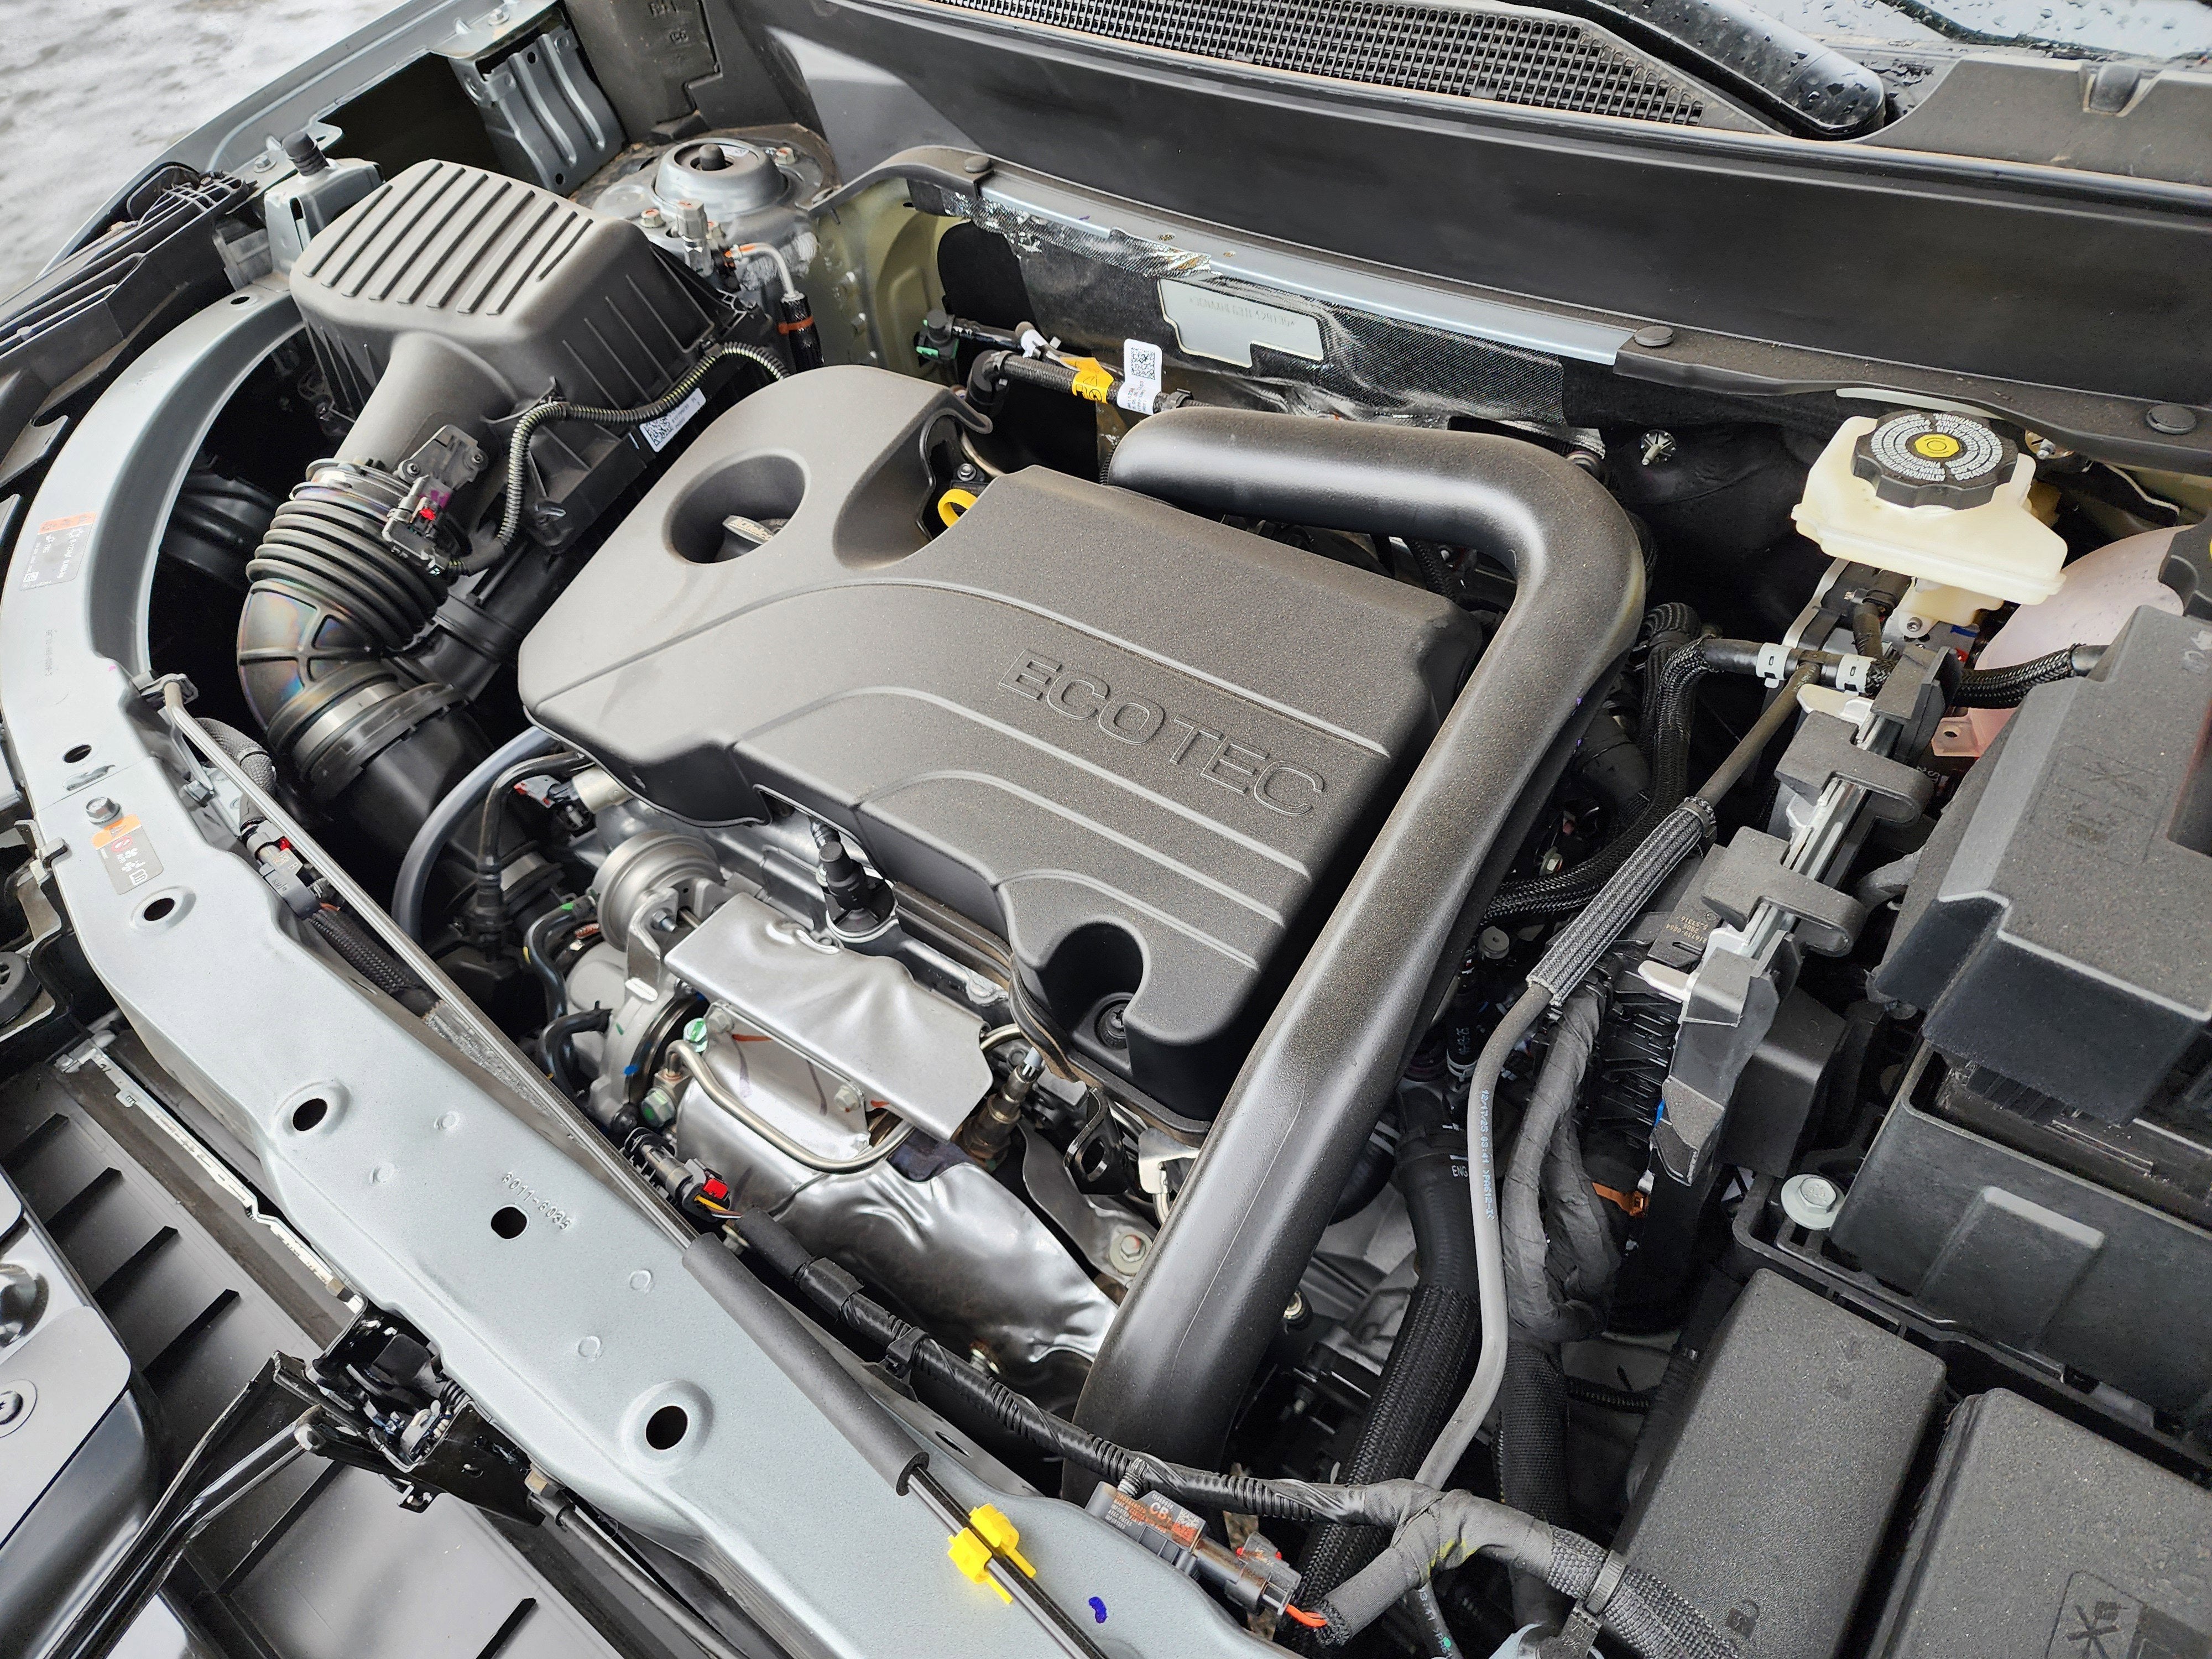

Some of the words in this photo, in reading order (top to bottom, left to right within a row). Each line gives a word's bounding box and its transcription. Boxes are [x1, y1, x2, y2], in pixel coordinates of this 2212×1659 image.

[998, 649, 1325, 816] ECOTEC
[116, 853, 126, 863] AUTO
[1451, 1165, 1469, 1177] ENG
[1149, 1501, 1170, 1521] CB
